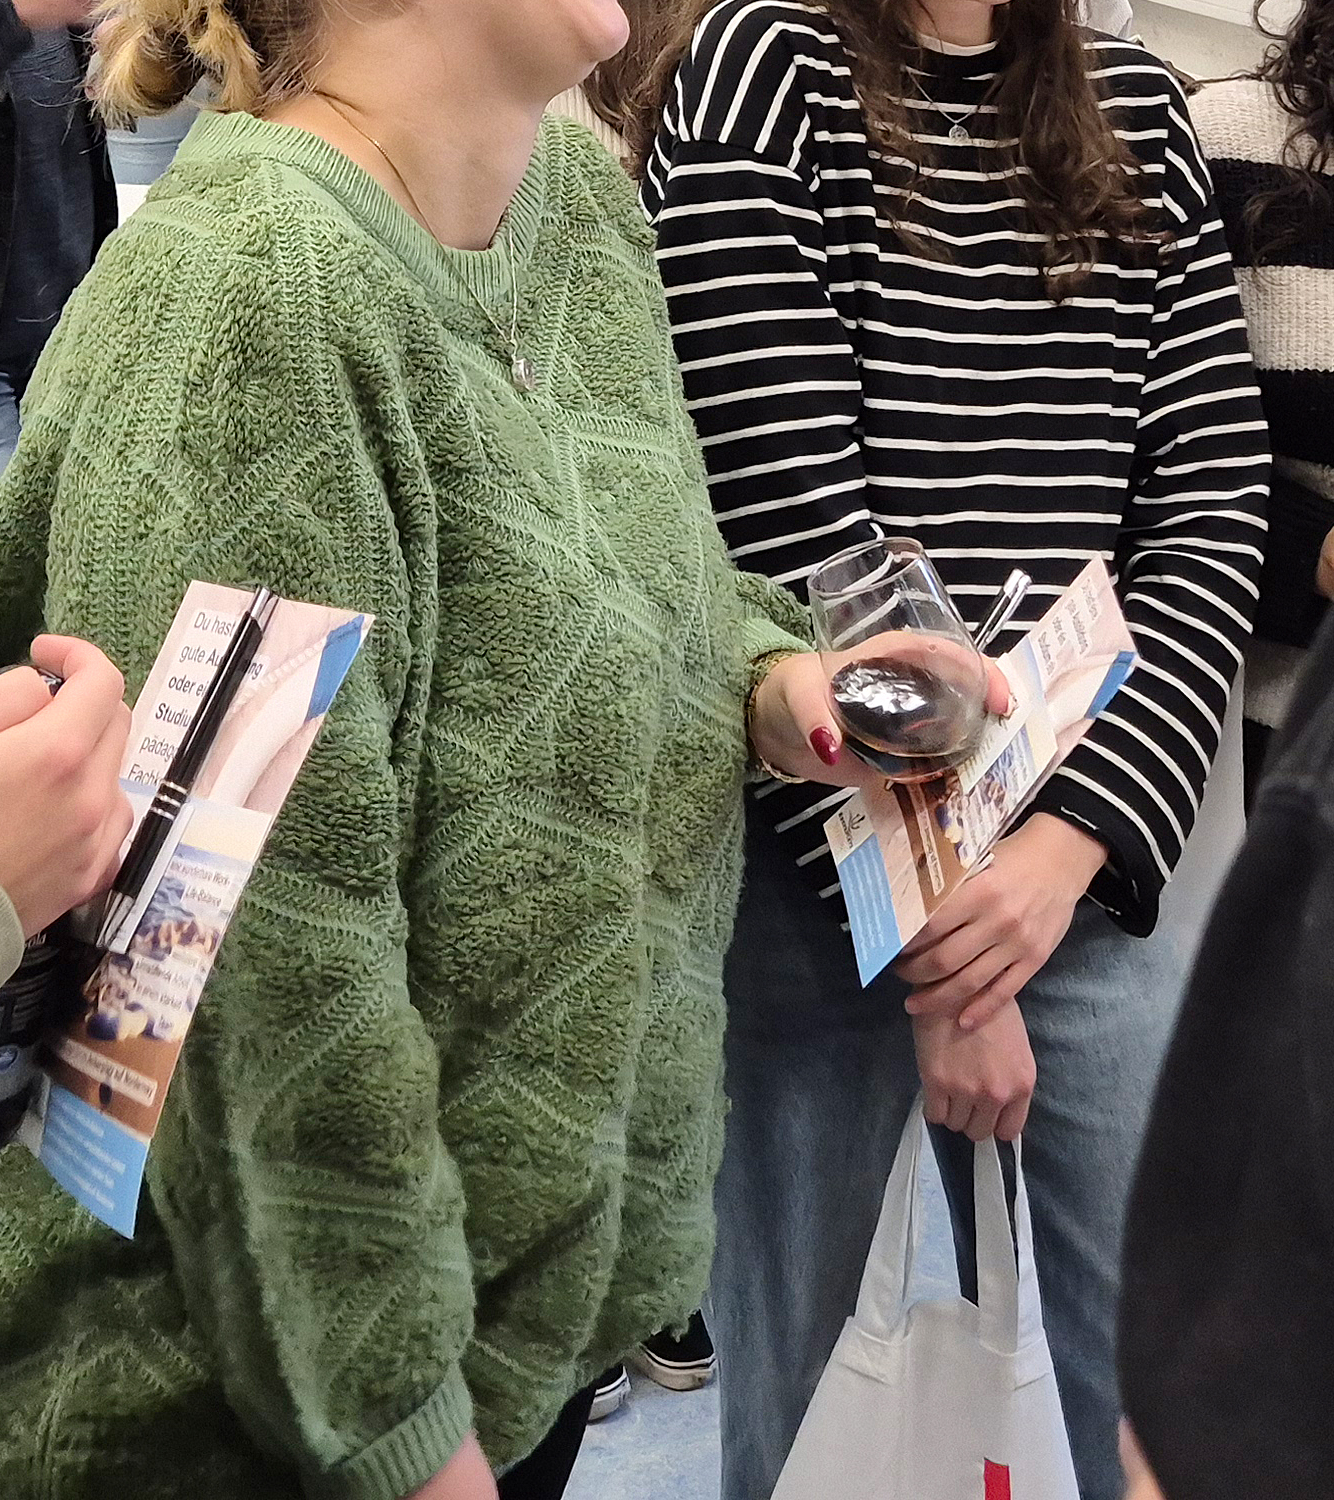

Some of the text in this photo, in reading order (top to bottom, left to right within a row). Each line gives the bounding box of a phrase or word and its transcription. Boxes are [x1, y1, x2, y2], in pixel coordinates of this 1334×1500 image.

[194, 611, 236, 637] Du hast
[179, 645, 206, 663] gute
[168, 674, 209, 697] oder ei
[155, 702, 192, 728] Studiu
